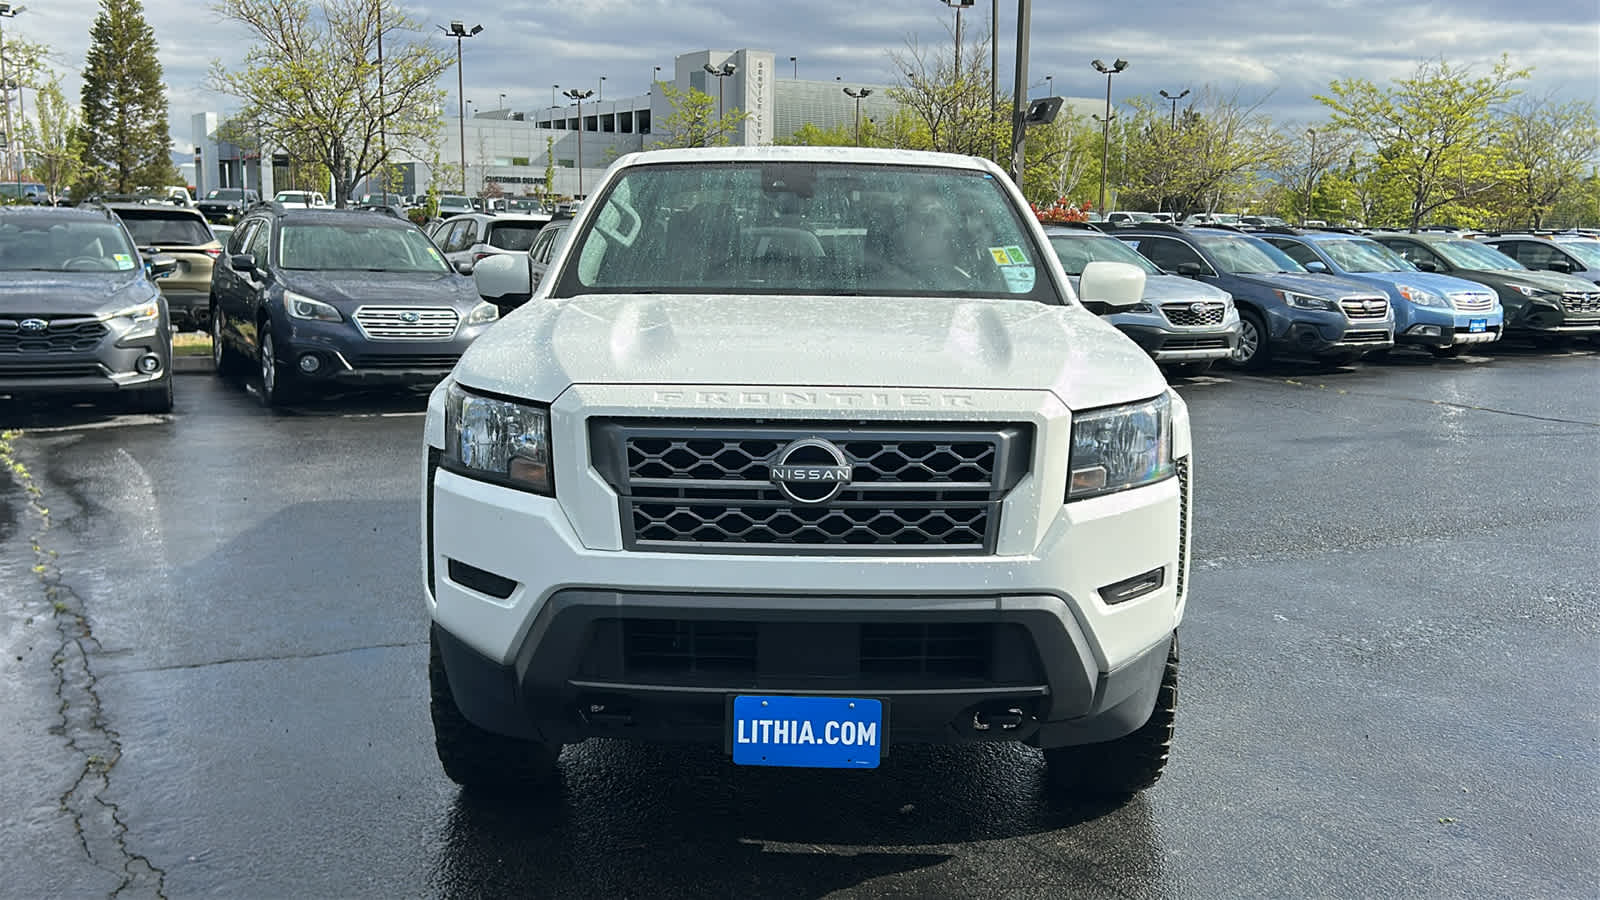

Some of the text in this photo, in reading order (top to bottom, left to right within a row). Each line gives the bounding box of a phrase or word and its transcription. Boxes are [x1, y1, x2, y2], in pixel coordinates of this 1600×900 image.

[485, 175, 521, 184] CUSTOMER
[653, 390, 976, 408] FRONTIER
[771, 468, 850, 481] NISSAN
[737, 719, 877, 746] LITHIA.COM
